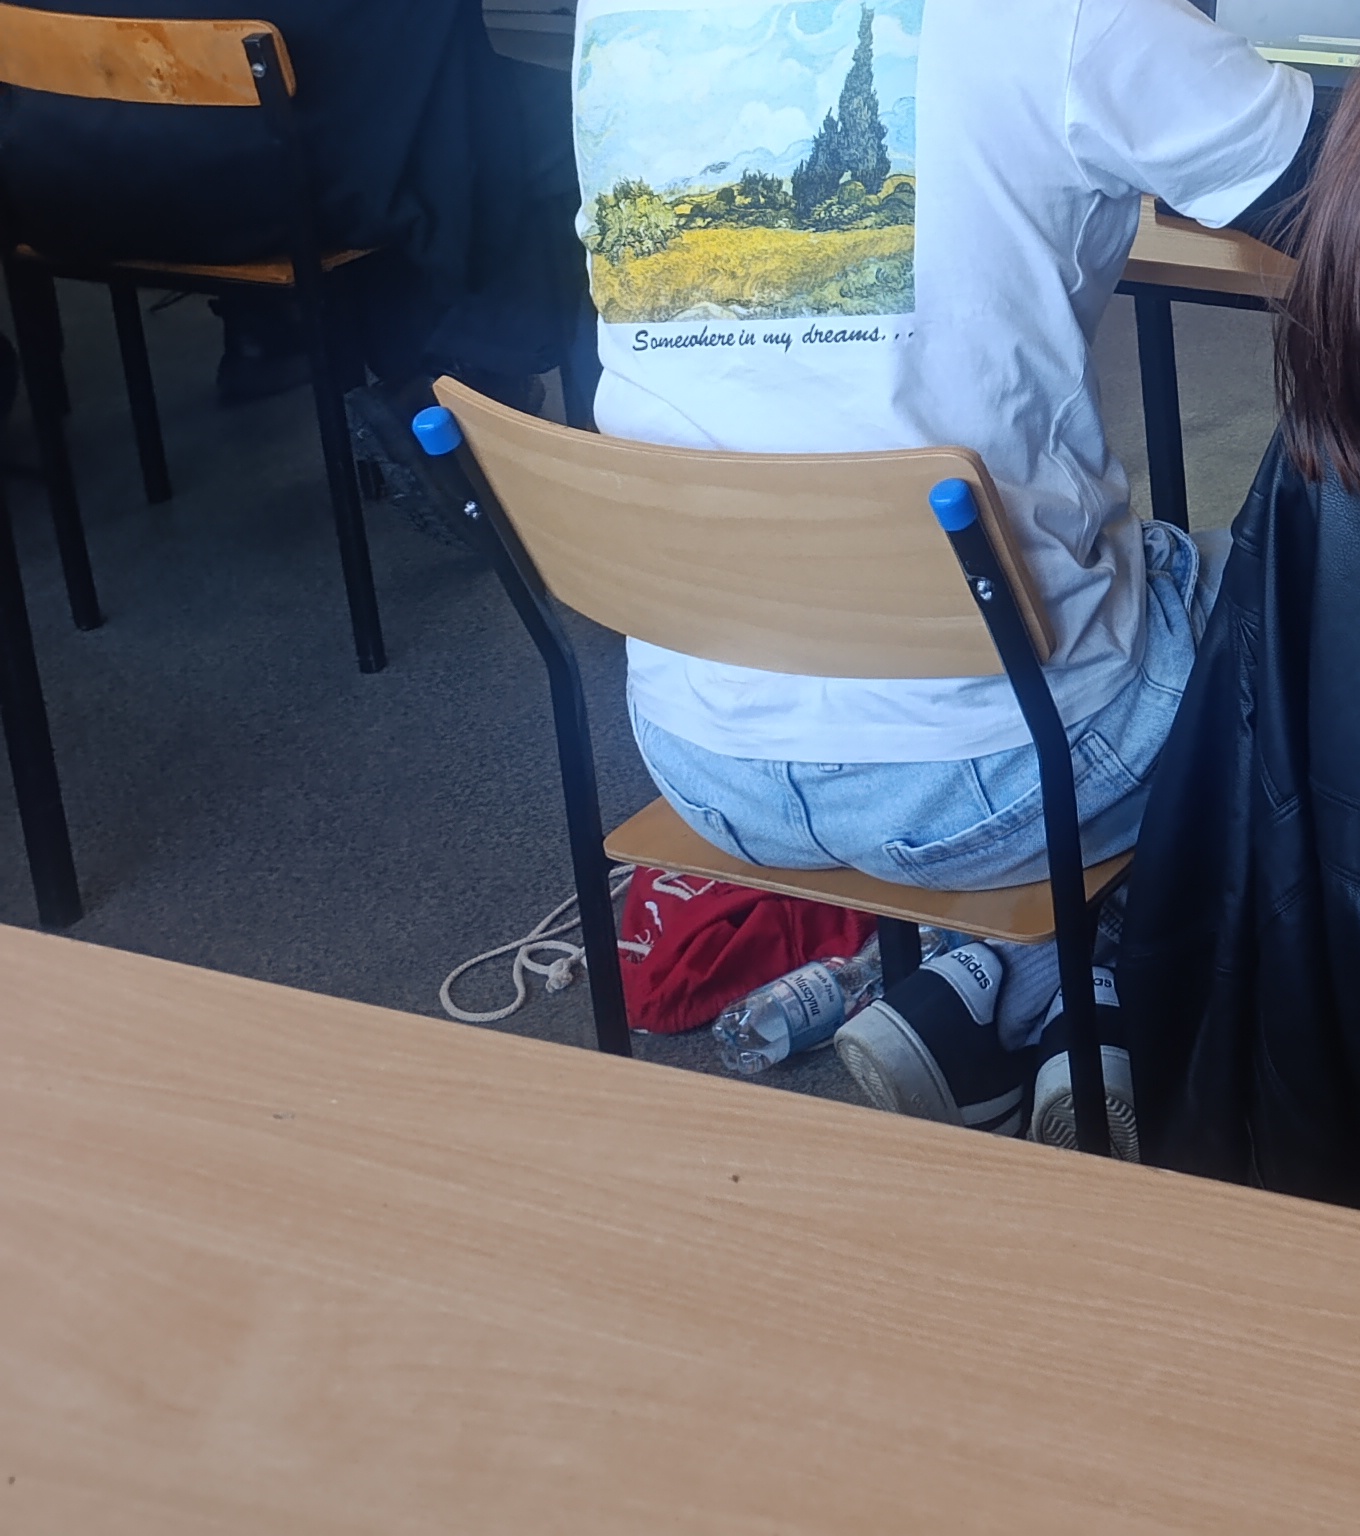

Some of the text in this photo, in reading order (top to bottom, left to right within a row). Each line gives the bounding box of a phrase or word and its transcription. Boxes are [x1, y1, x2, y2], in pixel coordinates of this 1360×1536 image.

[631, 324, 737, 352] Somewhere
[739, 328, 757, 346] in
[762, 332, 794, 354] my
[950, 950, 994, 991] adidas
[793, 973, 822, 1017] Muszyna
